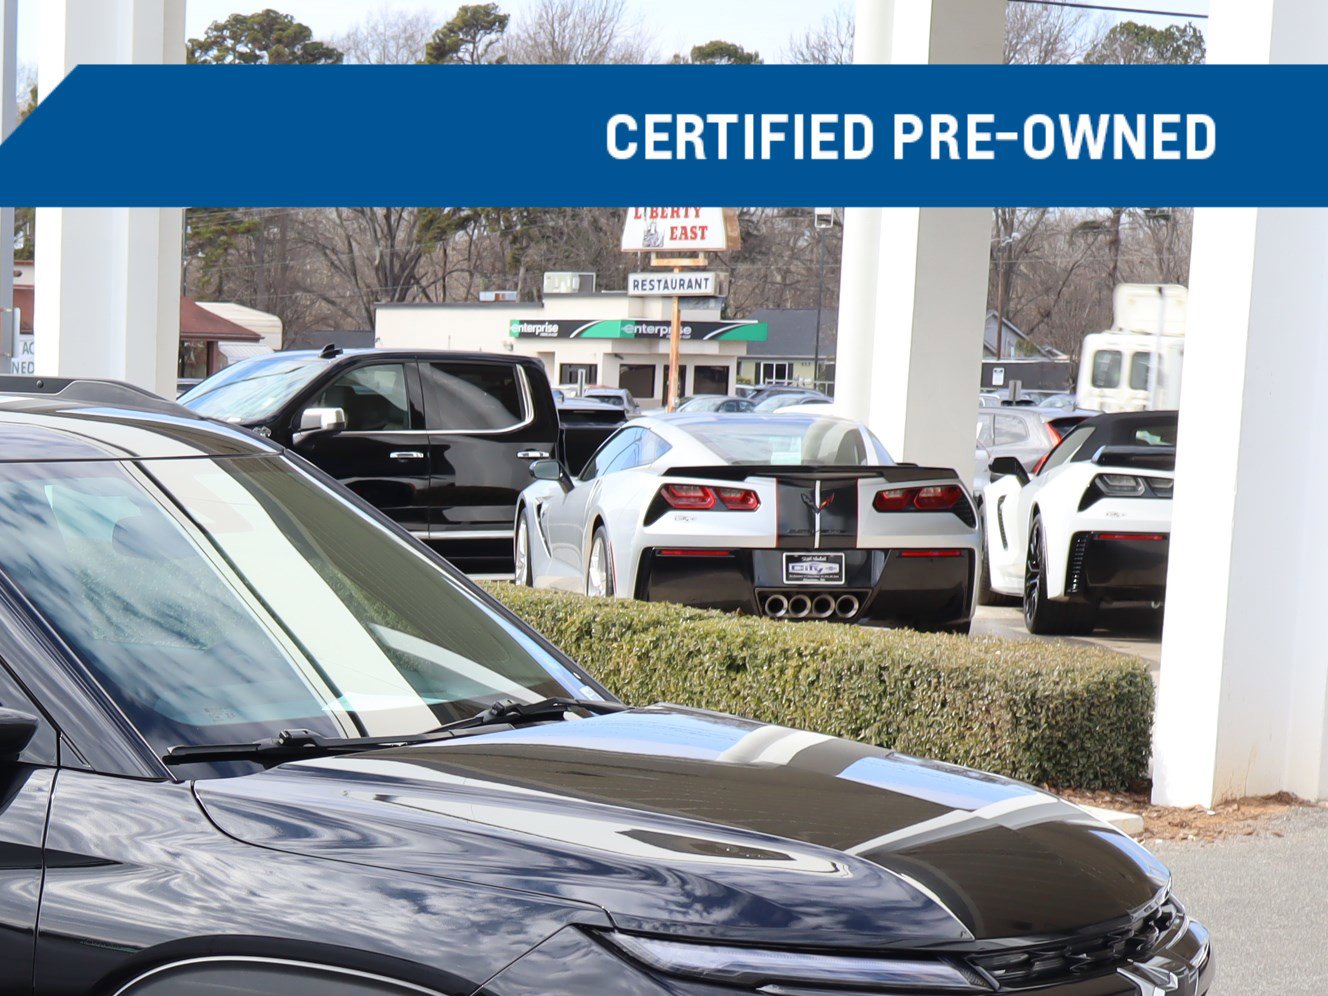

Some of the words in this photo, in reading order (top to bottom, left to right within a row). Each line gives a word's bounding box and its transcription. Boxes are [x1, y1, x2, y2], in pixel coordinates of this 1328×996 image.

[669, 226, 708, 241] EAST
[633, 278, 710, 291] RESTAURANT
[510, 321, 559, 335] enterprise
